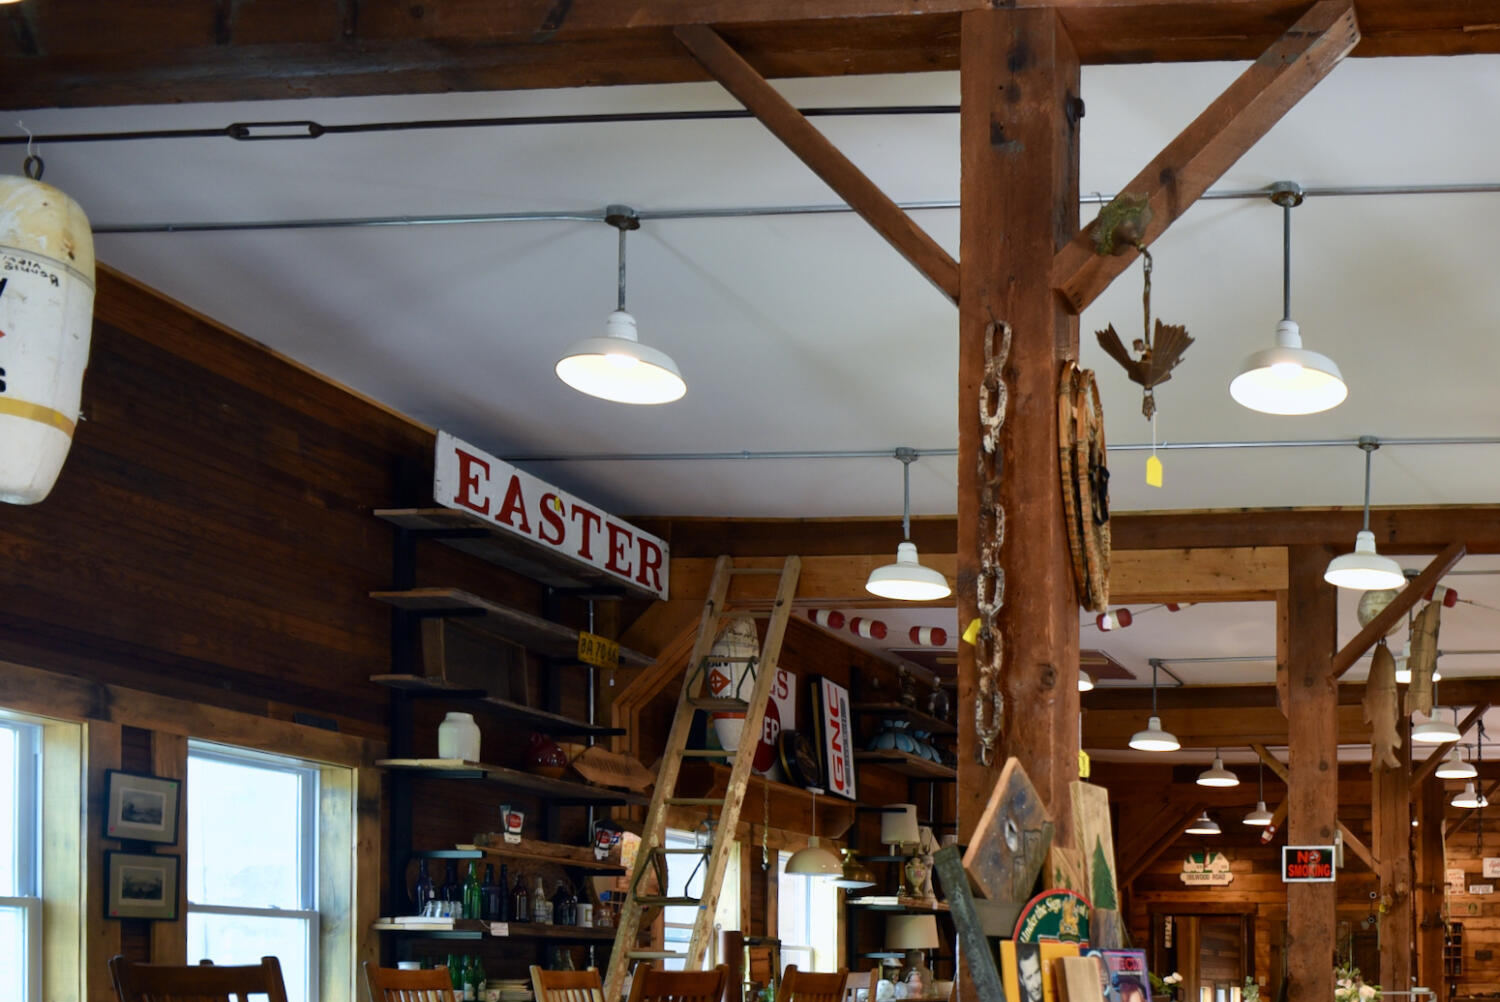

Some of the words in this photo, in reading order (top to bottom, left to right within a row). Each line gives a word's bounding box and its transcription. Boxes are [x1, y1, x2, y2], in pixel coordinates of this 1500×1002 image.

[454, 447, 663, 592] EASTER
[826, 683, 845, 791] GNC
[1288, 864, 1330, 877] SMOKING
[1297, 850, 1321, 864] NO
